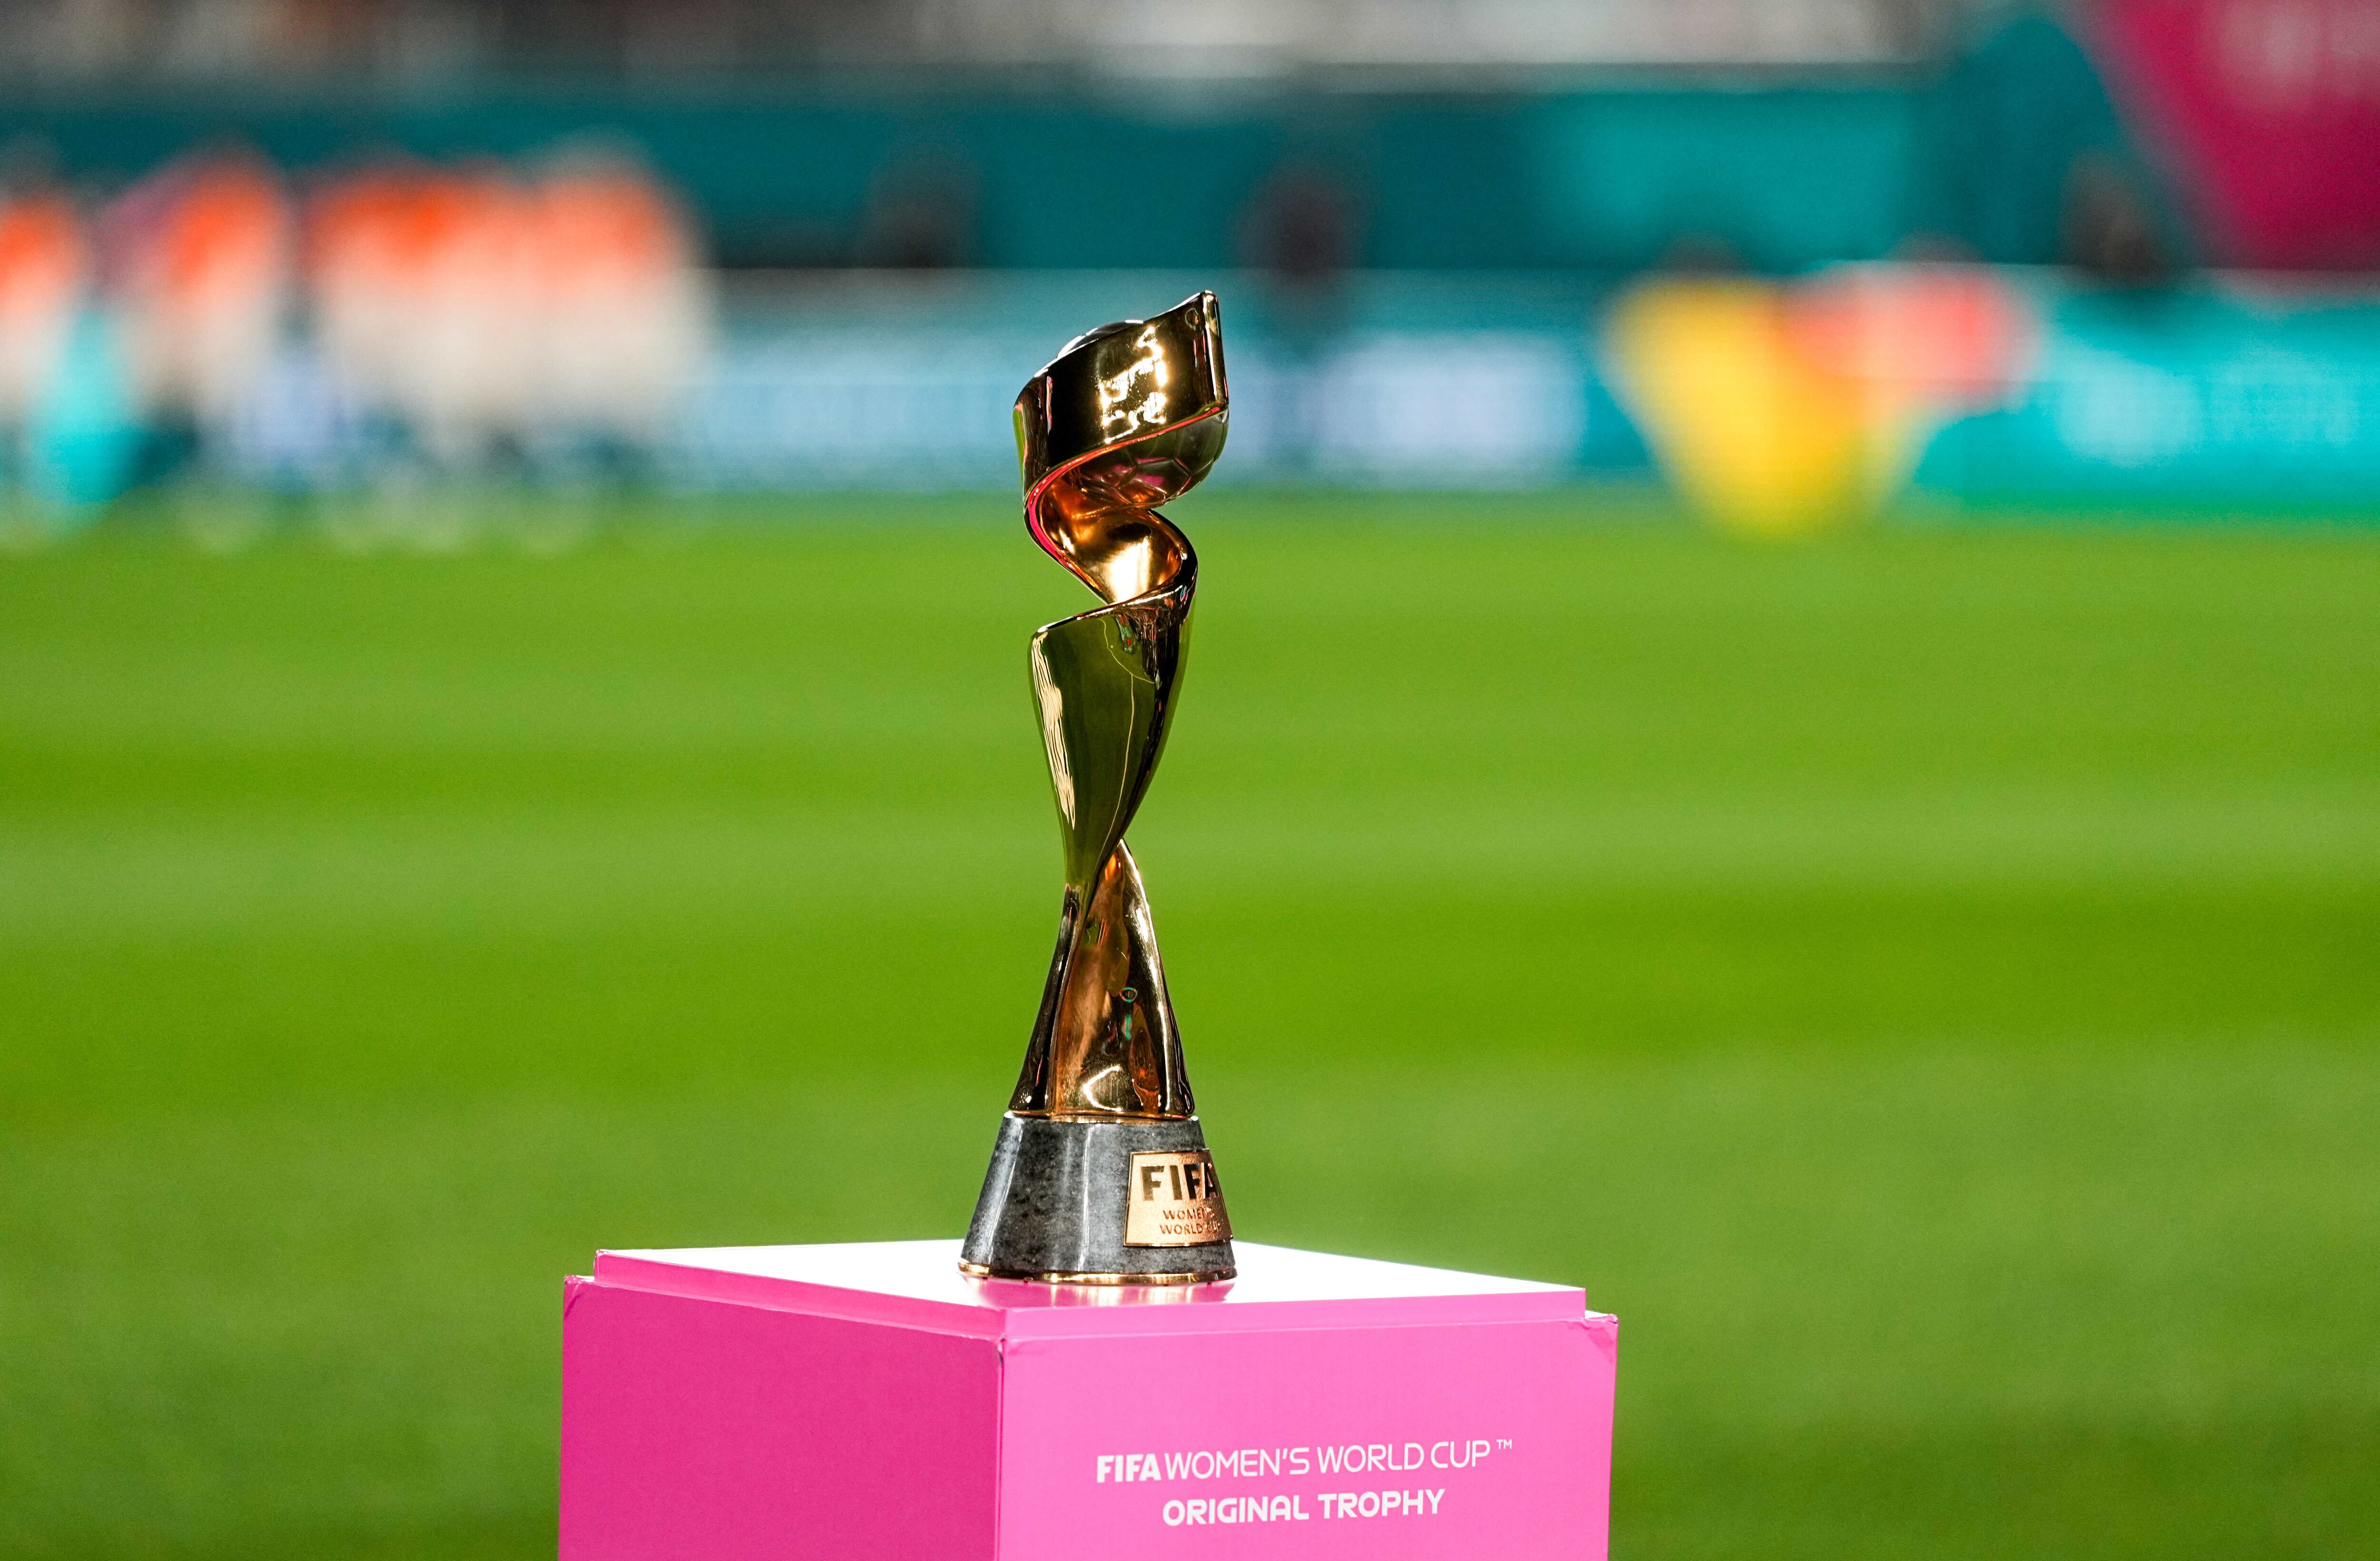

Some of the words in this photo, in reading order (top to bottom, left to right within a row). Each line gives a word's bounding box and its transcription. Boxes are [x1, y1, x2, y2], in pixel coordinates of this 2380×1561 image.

[1141, 1163, 1220, 1201] FIFA
[1160, 1223, 1203, 1234] WORLD
[1097, 1453, 1161, 1483] FIFA
[1165, 1447, 1309, 1480] WOMEN'S
[1317, 1443, 1424, 1473] WORLD
[1163, 1495, 1309, 1526] ORIGINAL
[1318, 1489, 1445, 1519] TROPHY
